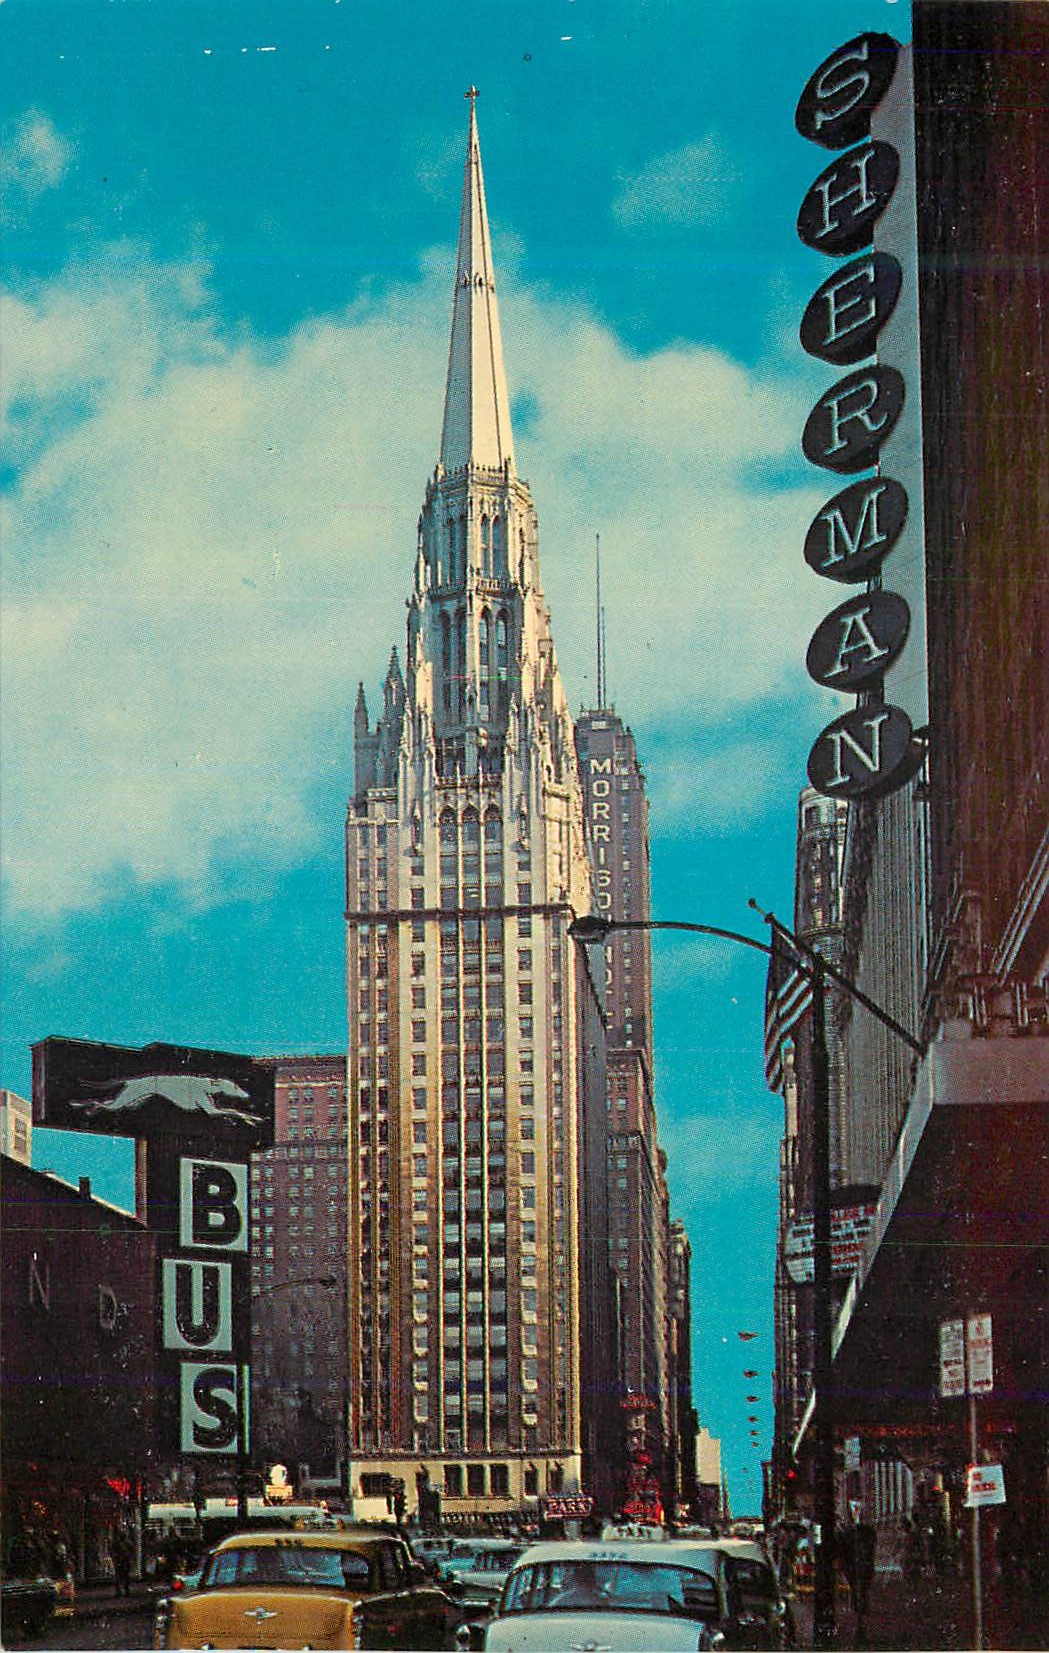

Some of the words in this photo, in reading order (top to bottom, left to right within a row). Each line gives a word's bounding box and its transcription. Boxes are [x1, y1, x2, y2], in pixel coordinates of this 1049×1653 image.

[814, 45, 891, 789] SHERMAN
[590, 757, 614, 926] MORRISO
[174, 1161, 239, 1450] BUS
